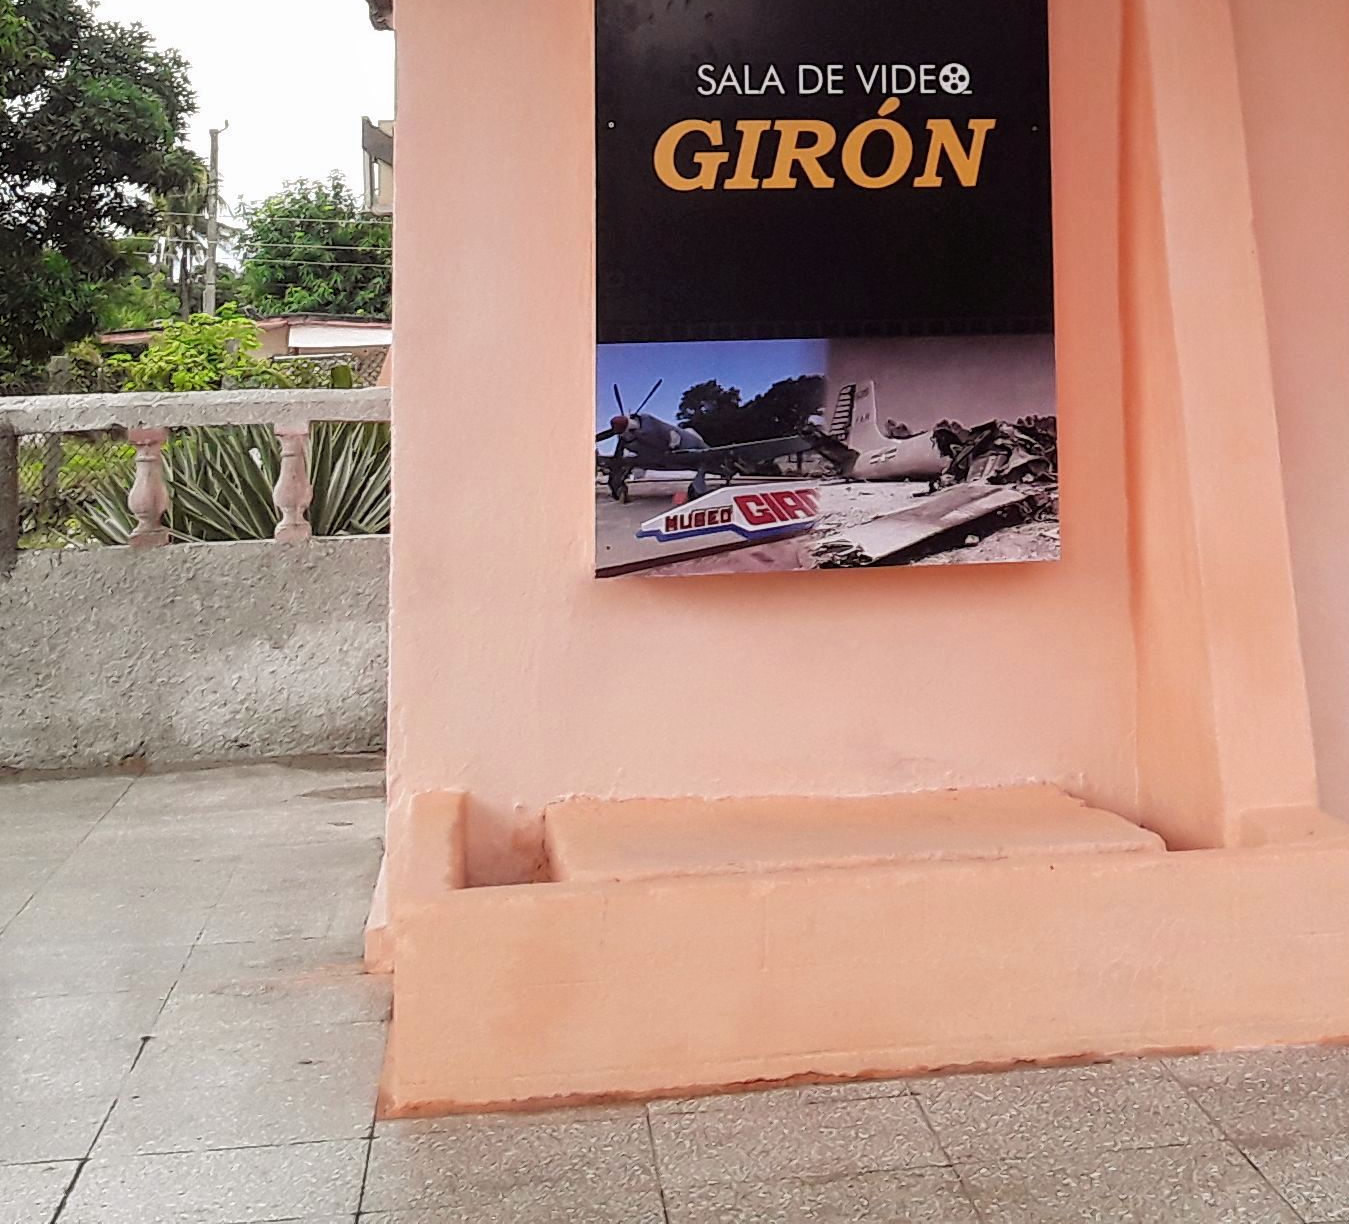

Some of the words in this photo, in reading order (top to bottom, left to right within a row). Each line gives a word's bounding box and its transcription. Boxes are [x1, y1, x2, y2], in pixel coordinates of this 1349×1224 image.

[697, 64, 785, 94] SALA
[798, 64, 844, 94] DE
[653, 96, 997, 191] GIRÓN
